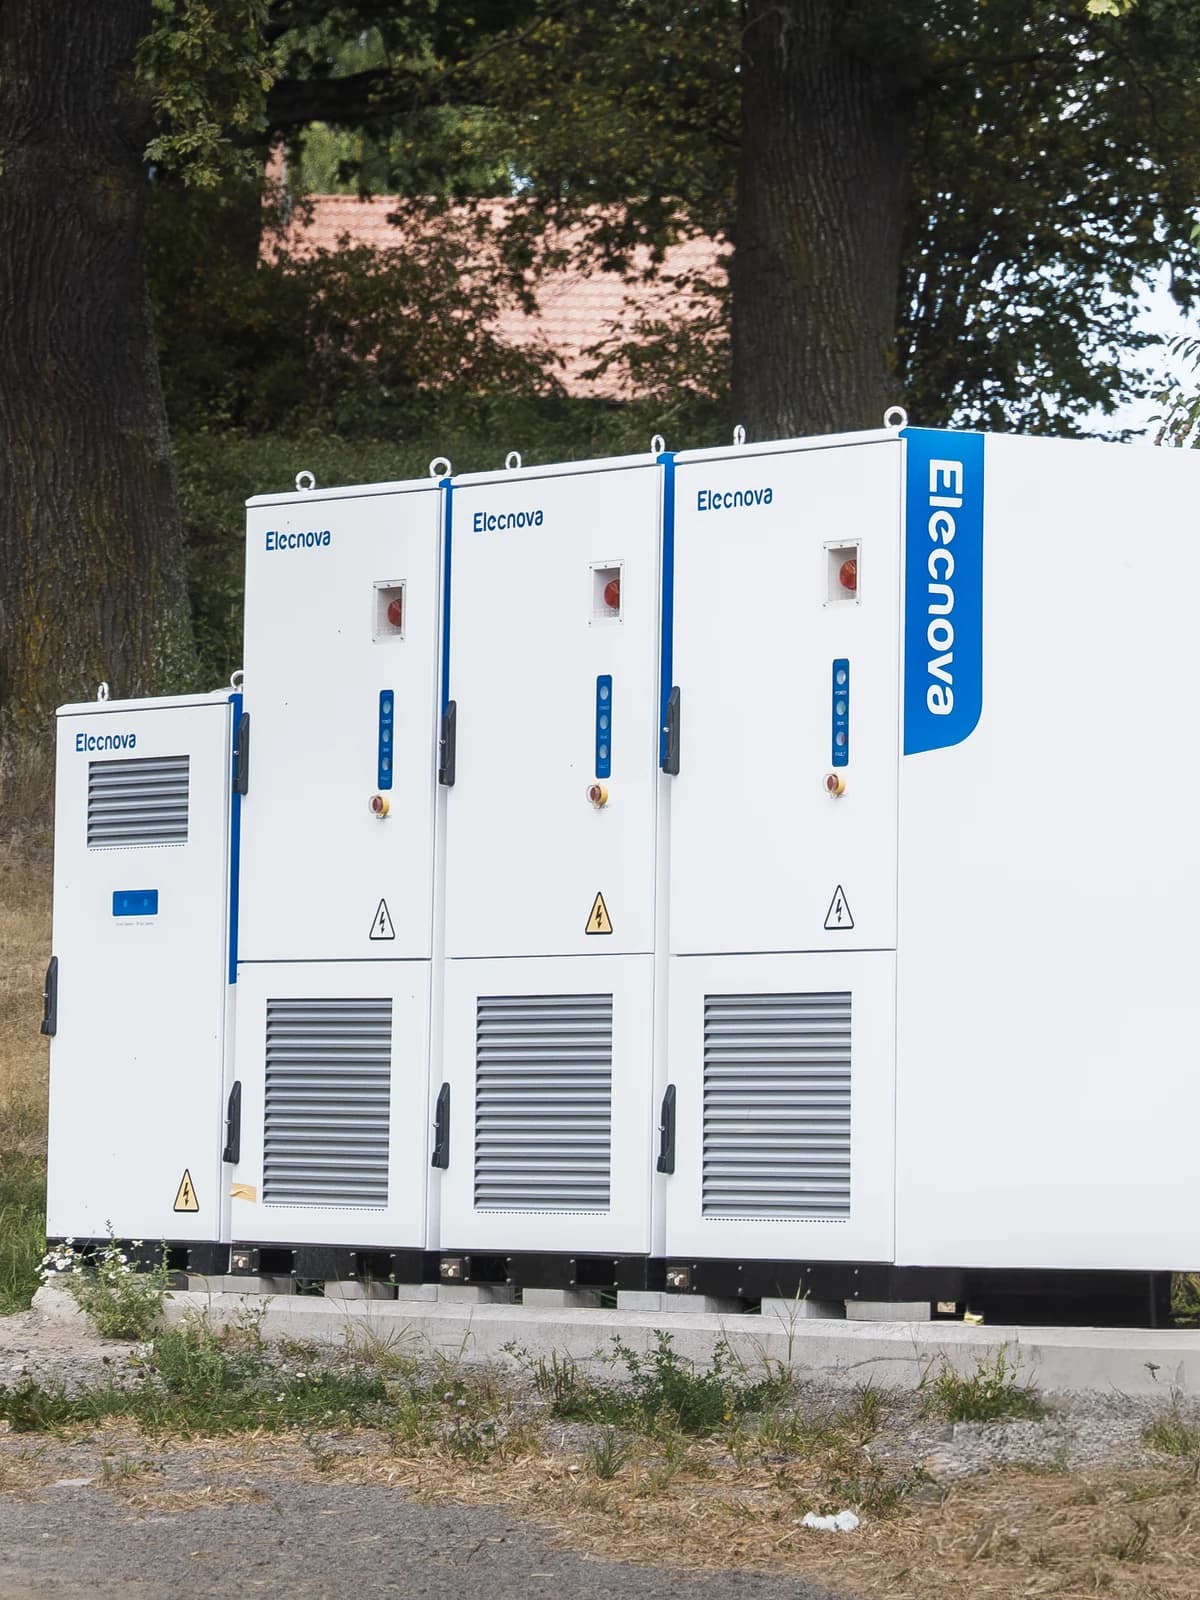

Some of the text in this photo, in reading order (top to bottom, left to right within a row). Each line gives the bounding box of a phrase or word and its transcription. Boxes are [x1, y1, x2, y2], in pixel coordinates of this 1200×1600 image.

[697, 487, 773, 512] Elecnova
[473, 509, 544, 533] Elecnova
[265, 530, 331, 552] Elecnova
[927, 459, 963, 715] Elecnova
[75, 732, 137, 753] Elecnova
